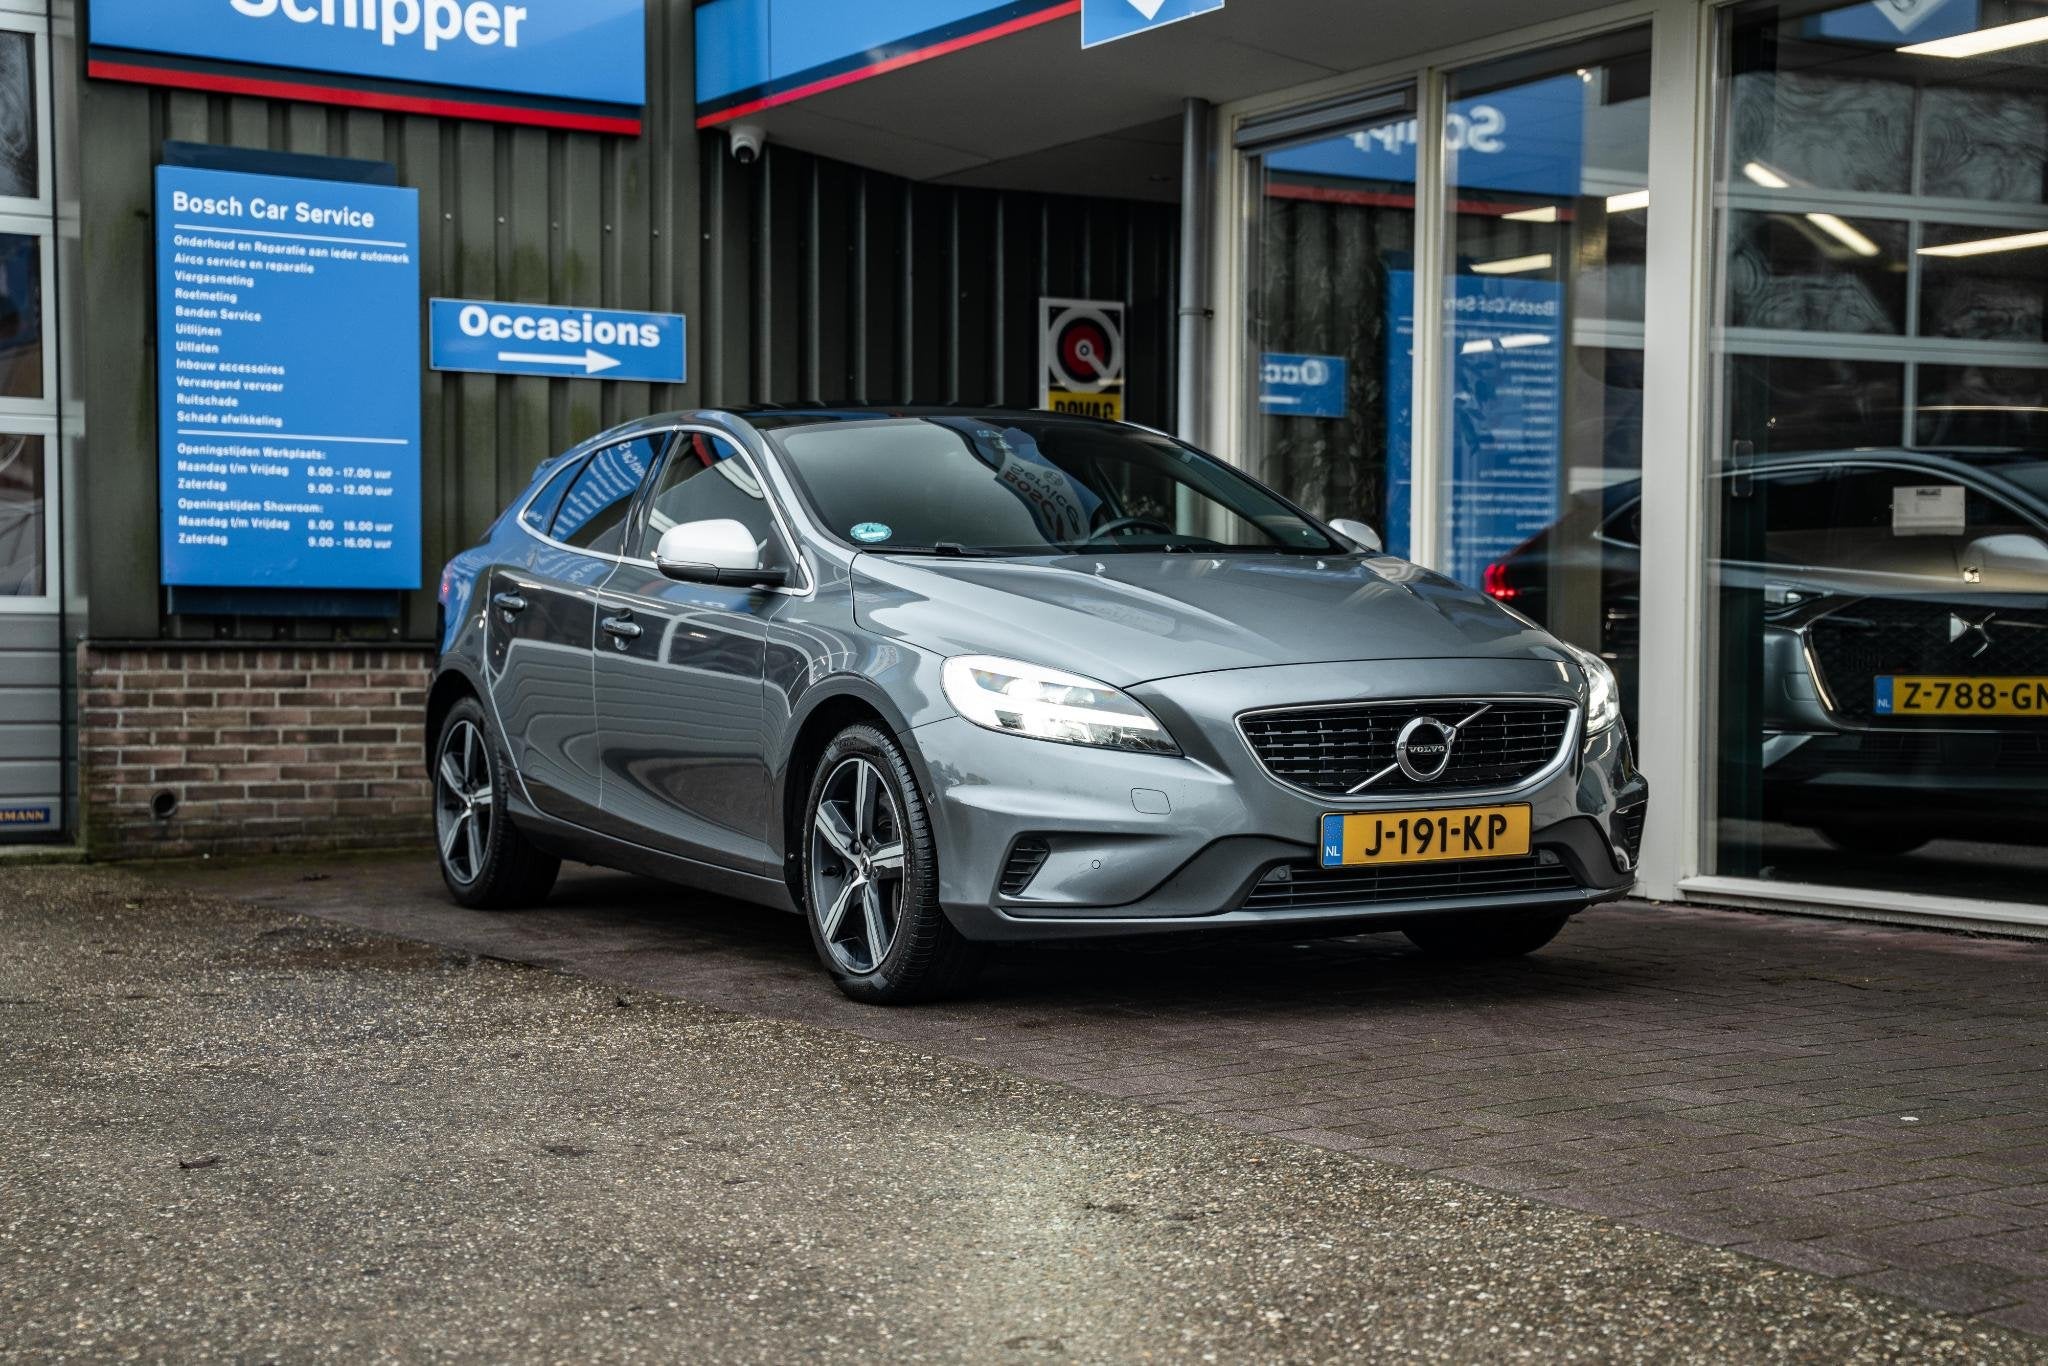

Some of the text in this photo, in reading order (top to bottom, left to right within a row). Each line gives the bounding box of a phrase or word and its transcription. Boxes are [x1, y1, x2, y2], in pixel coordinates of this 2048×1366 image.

[172, 190, 375, 228] Bosch Car Service
[174, 235, 235, 250] Onderhoud
[238, 242, 251, 252] en
[254, 242, 306, 256] Reparatie
[308, 248, 329, 258] aan
[360, 251, 410, 264] automerk
[174, 252, 314, 274] Airco service en reparatie
[174, 270, 254, 288] Viergasmeting
[175, 288, 239, 304] Roetmeting
[176, 306, 262, 322] Banden Service
[176, 323, 222, 337] Uitlijnen
[458, 305, 661, 348] Occasions
[176, 340, 220, 354] Uitlaten
[176, 358, 285, 376] Inbouw accessoires
[176, 376, 284, 392] Vervangend vervoer
[176, 393, 239, 407] Ruitschade
[176, 410, 283, 428] Schade afwikkeling
[177, 442, 326, 460] Openingstijden Werkplaats:
[178, 460, 228, 474] Maandag
[230, 462, 248, 474] t/m
[250, 463, 289, 477] Vrijdag
[374, 470, 392, 479] uur
[178, 478, 228, 492] Zaterdag
[307, 482, 334, 494] 9.00
[374, 488, 393, 496] uur
[178, 498, 324, 514] Openingstijden Showroom:
[178, 515, 228, 529] Maandag
[230, 516, 248, 528] t/m
[251, 517, 290, 530] Vrijdag
[374, 524, 394, 532] uur
[178, 532, 228, 546] Zaterdag
[308, 536, 334, 548] 9.00
[374, 540, 392, 549] uur
[1877, 700, 1891, 709] NL
[1408, 745, 1444, 753] VOLVO
[0, 811, 44, 820] MANN
[1326, 814, 1507, 857] NL J-191-KP
